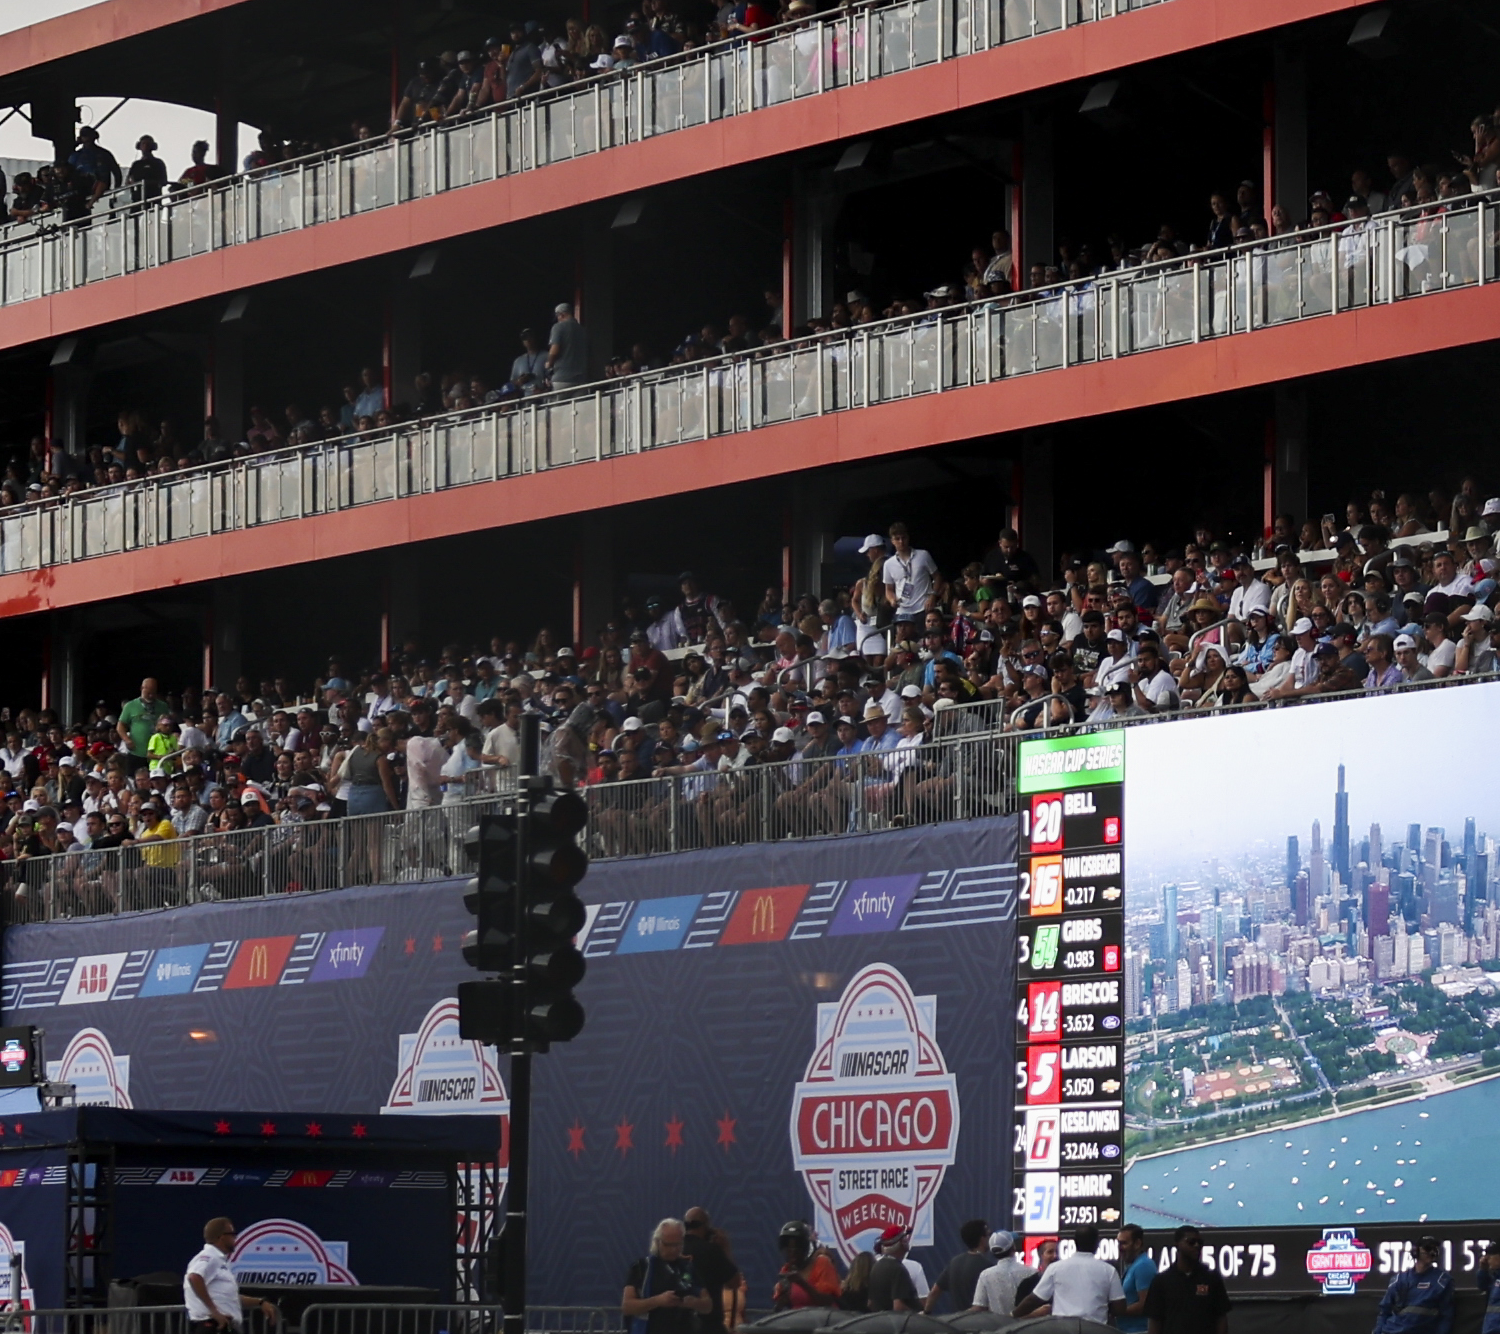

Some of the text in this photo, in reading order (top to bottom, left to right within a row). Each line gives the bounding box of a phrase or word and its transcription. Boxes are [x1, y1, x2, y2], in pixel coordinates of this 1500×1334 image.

[1024, 744, 1123, 776] NASCAR CUP SERIES
[1023, 792, 1097, 844] 1 20 BELL
[1020, 872, 1031, 900] 2
[1033, 864, 1061, 907] 16
[1063, 857, 1080, 879] VAN
[1064, 887, 1096, 905] -0.217
[853, 891, 896, 921] xfinity
[1018, 918, 1103, 970] 3 54 GIBBS
[1063, 950, 1095, 968] -0.983
[78, 963, 108, 995] ABB
[329, 940, 365, 968] xfinity
[1017, 981, 1119, 1034] 4 14 BRISCOE
[1062, 1014, 1095, 1032] -3.632
[856, 1049, 910, 1078] NASCAR
[1016, 1045, 1117, 1097] 5 5 LARSON
[431, 1077, 477, 1102] NASCAR
[1061, 1077, 1095, 1097] -5.050
[812, 1096, 937, 1150] CHICAGO
[1029, 1118, 1057, 1161] 6
[1061, 1110, 1120, 1134] KESELOWSKI
[1061, 1142, 1100, 1160] -32.044
[169, 1171, 195, 1182] ABB
[838, 1166, 909, 1191] STREET RACE
[1029, 1185, 1055, 1221] 31
[1060, 1174, 1113, 1197] HEMRIC
[841, 1201, 905, 1231] WEEKEND
[1060, 1206, 1098, 1224] -37.951
[1219, 1245, 1245, 1277] OF
[1248, 1244, 1277, 1277] 75
[1312, 1252, 1367, 1269] GRANT PARK 165
[1443, 1240, 1452, 1272] 1
[1463, 1239, 1475, 1272] 5
